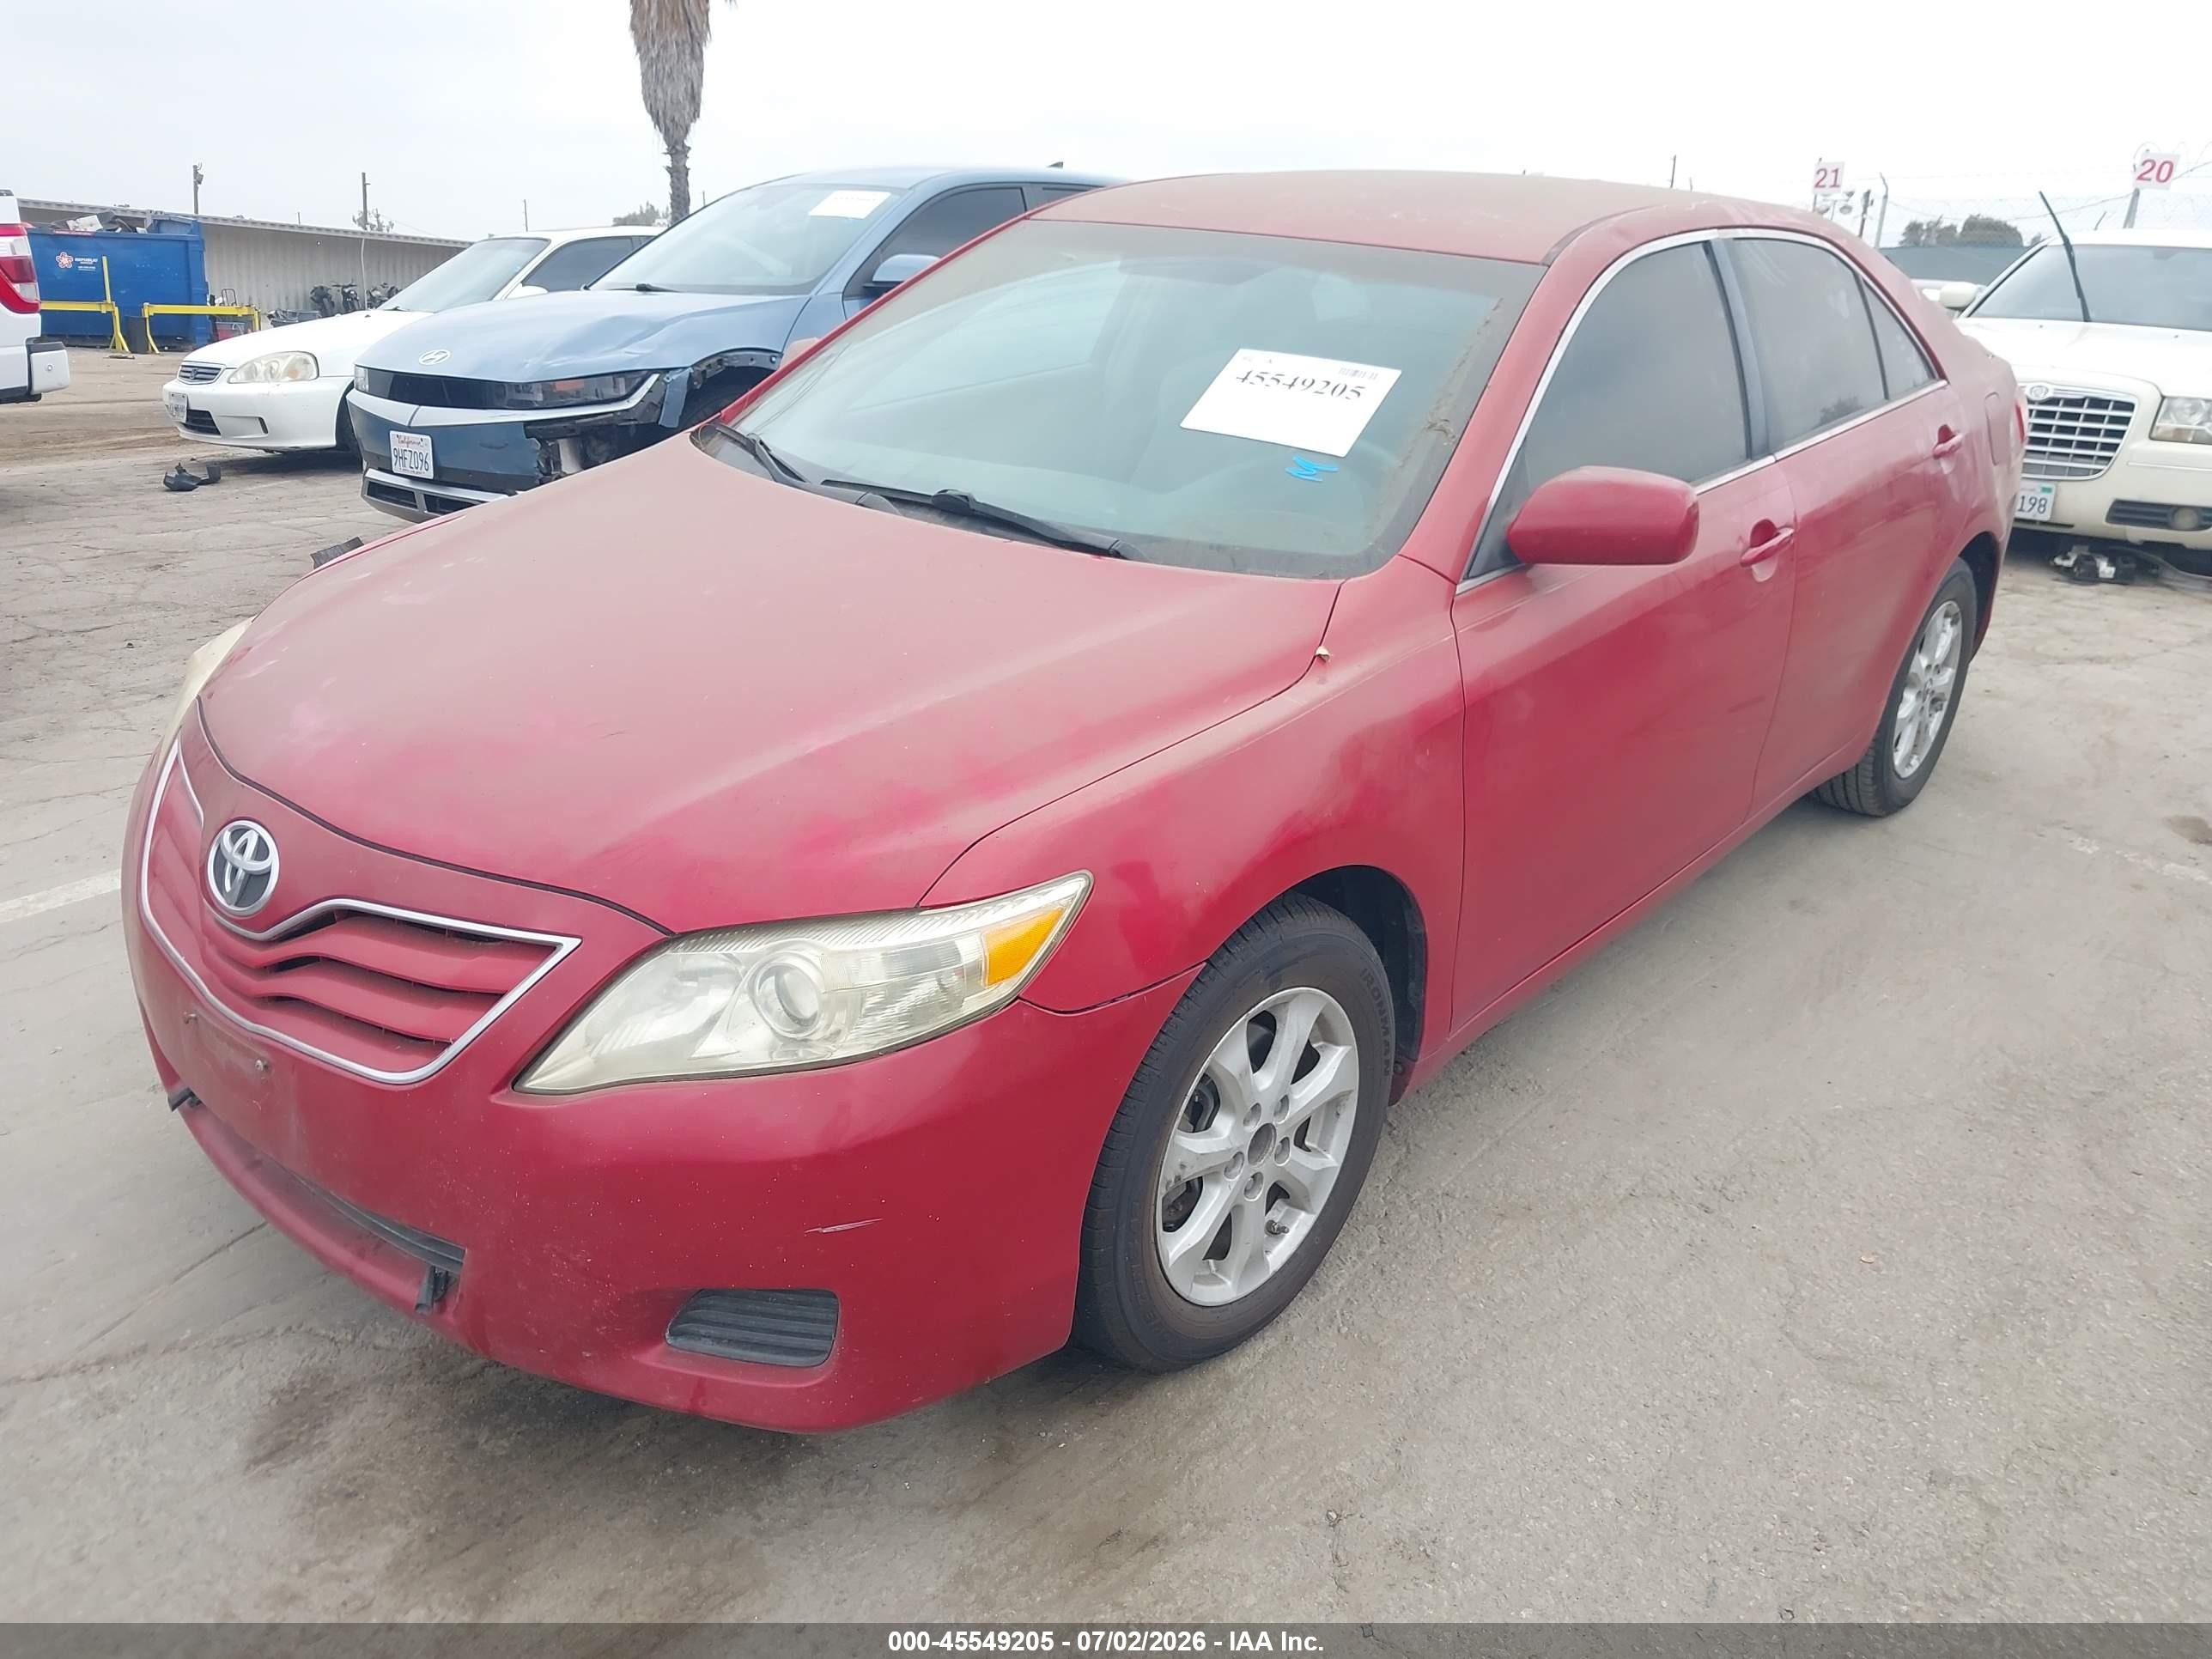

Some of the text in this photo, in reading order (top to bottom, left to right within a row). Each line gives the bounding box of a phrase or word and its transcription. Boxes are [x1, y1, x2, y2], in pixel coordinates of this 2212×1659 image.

[1814, 167, 1840, 188] 21
[2136, 159, 2173, 183] 20
[1236, 369, 1365, 400] 45549205
[392, 447, 429, 471] 9HFZ096
